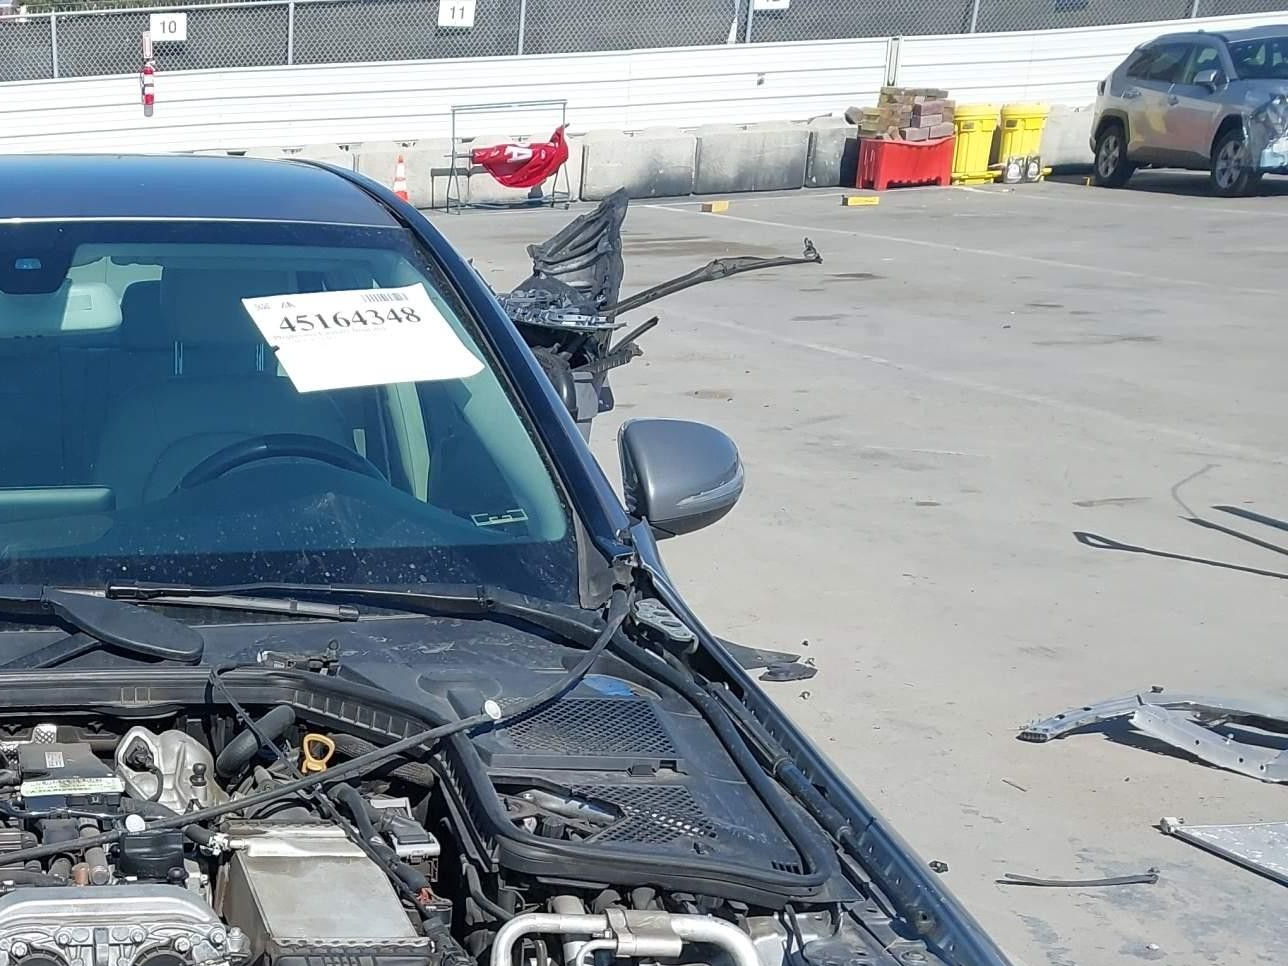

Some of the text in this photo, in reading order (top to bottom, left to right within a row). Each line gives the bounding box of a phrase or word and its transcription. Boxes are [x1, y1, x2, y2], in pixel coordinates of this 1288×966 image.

[450, 5, 465, 20] 11
[159, 20, 177, 34] 10
[279, 306, 421, 332] 45164348
